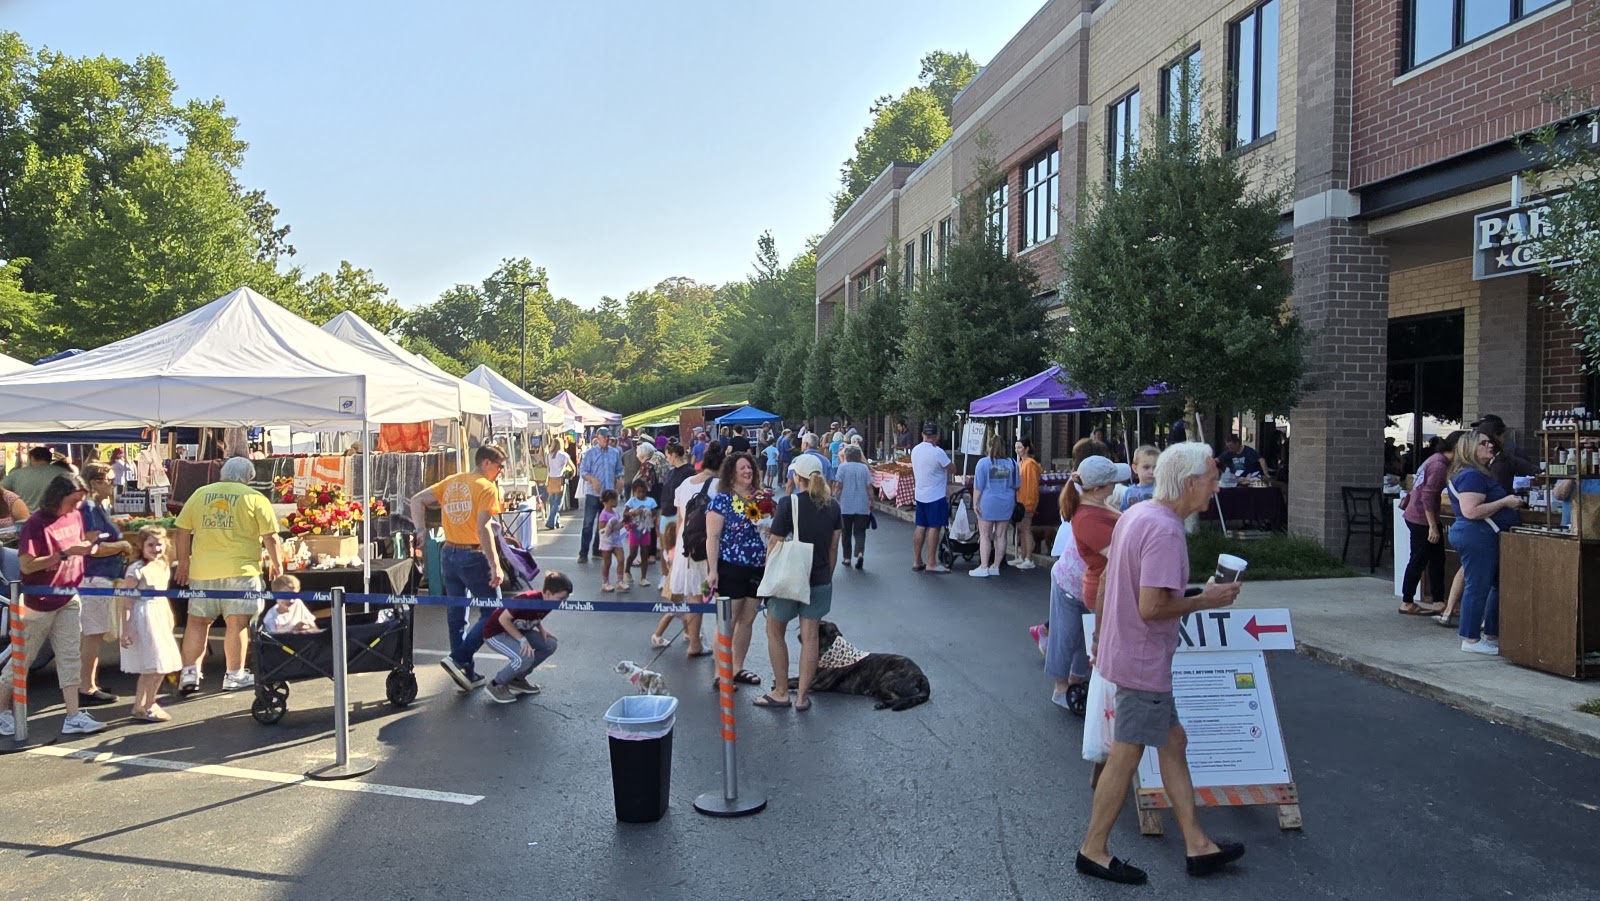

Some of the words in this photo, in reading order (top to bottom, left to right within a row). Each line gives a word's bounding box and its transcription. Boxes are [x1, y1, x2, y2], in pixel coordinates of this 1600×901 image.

[1479, 206, 1556, 250] PAR
[53, 587, 79, 595] Marshalls
[113, 588, 141, 597] Marshalls
[177, 590, 206, 598] Marshalls
[243, 591, 274, 600] Marshalls
[386, 595, 418, 605] Marshalls
[469, 597, 504, 608] Marshalls
[558, 601, 594, 611] Marshalls
[652, 603, 690, 613] Marshalls
[1178, 612, 1231, 647] XIT
